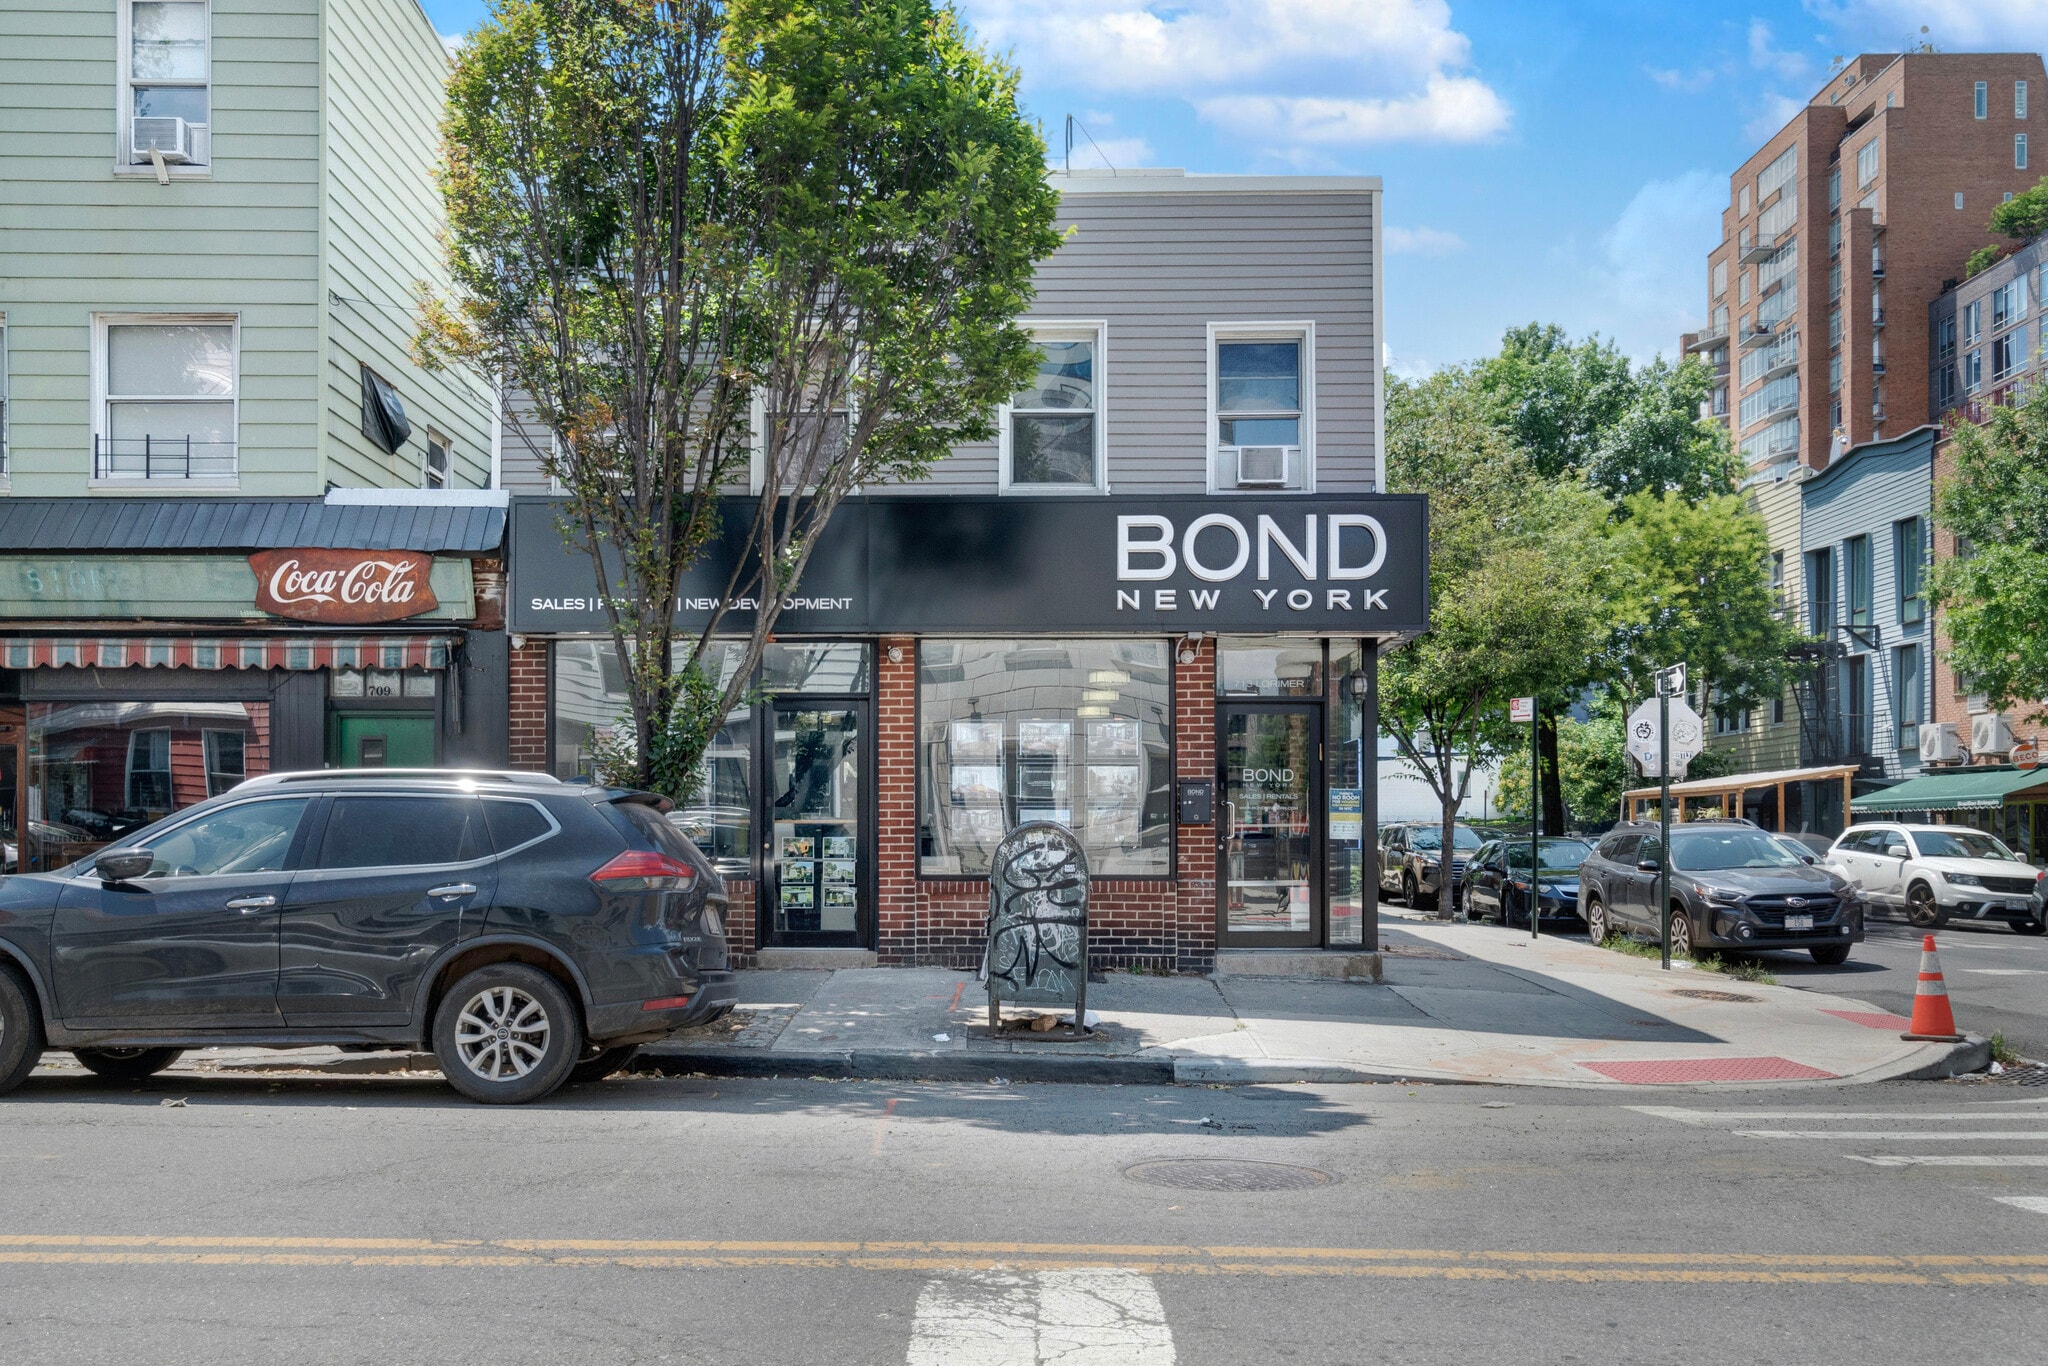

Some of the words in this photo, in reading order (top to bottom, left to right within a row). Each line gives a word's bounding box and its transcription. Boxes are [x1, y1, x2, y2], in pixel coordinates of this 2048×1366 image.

[1117, 513, 1388, 582] BOND
[269, 559, 418, 604] Coca-Cola
[531, 598, 585, 610] SALES
[686, 598, 721, 610] NEW
[728, 598, 853, 610] DEVOPMENT
[1116, 589, 1221, 611] NEW
[1252, 589, 1389, 611] YORK
[1257, 679, 1305, 688] LORIMER
[368, 686, 391, 696] 709
[2013, 751, 2039, 763] BECO
[1242, 768, 1295, 782] BOND
